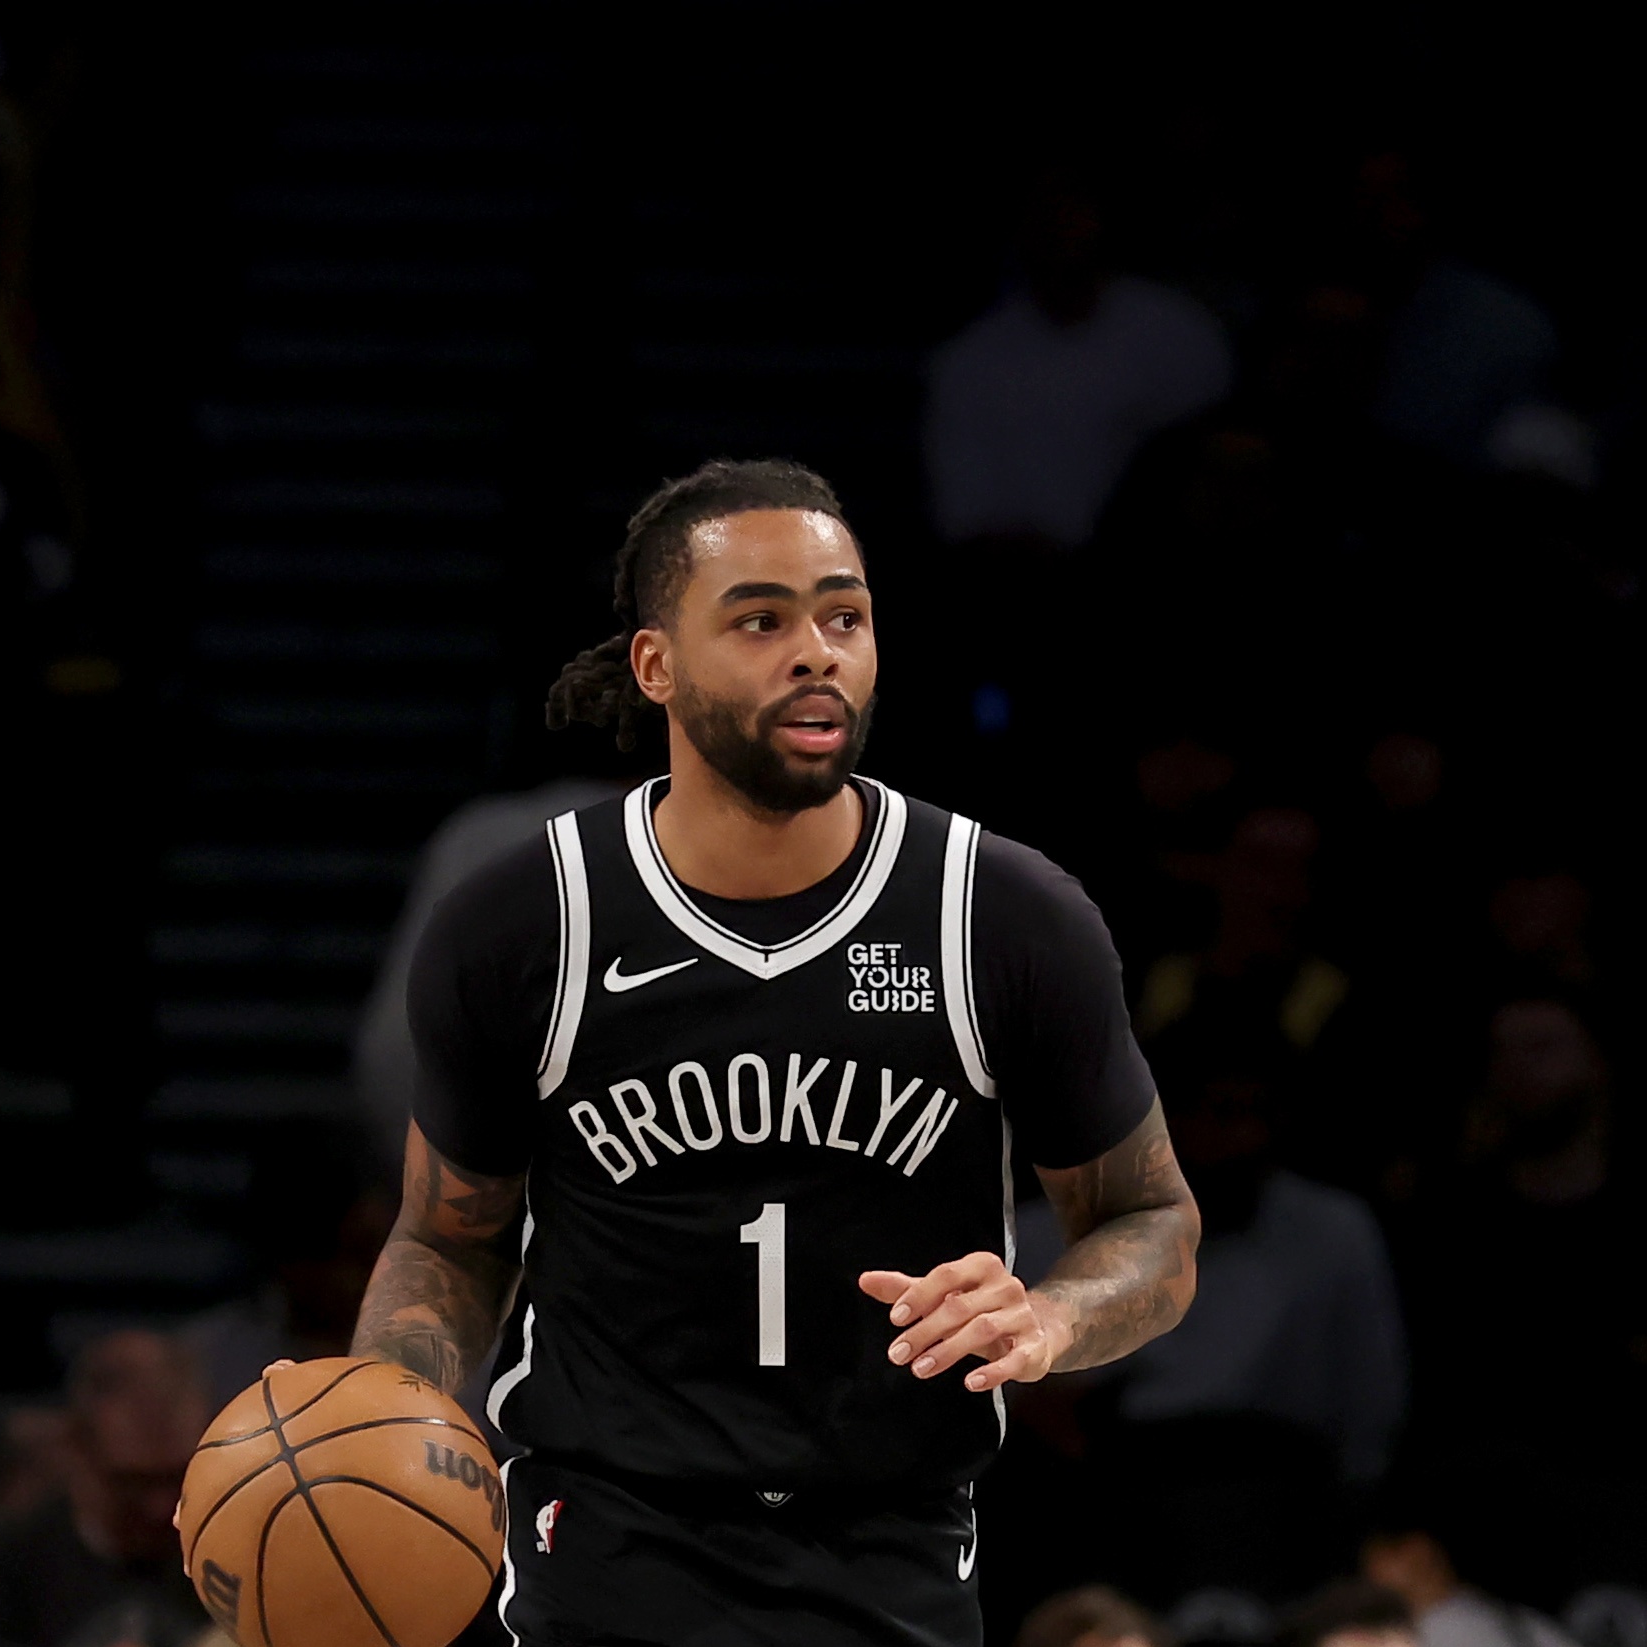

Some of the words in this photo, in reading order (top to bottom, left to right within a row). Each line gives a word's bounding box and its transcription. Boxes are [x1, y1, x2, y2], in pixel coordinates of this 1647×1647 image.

[847, 943, 901, 965] GET
[848, 966, 930, 988] YOUR
[848, 989, 935, 1012] GUIDE
[568, 1053, 959, 1185] BROOKLYN
[740, 1203, 786, 1367] 1
